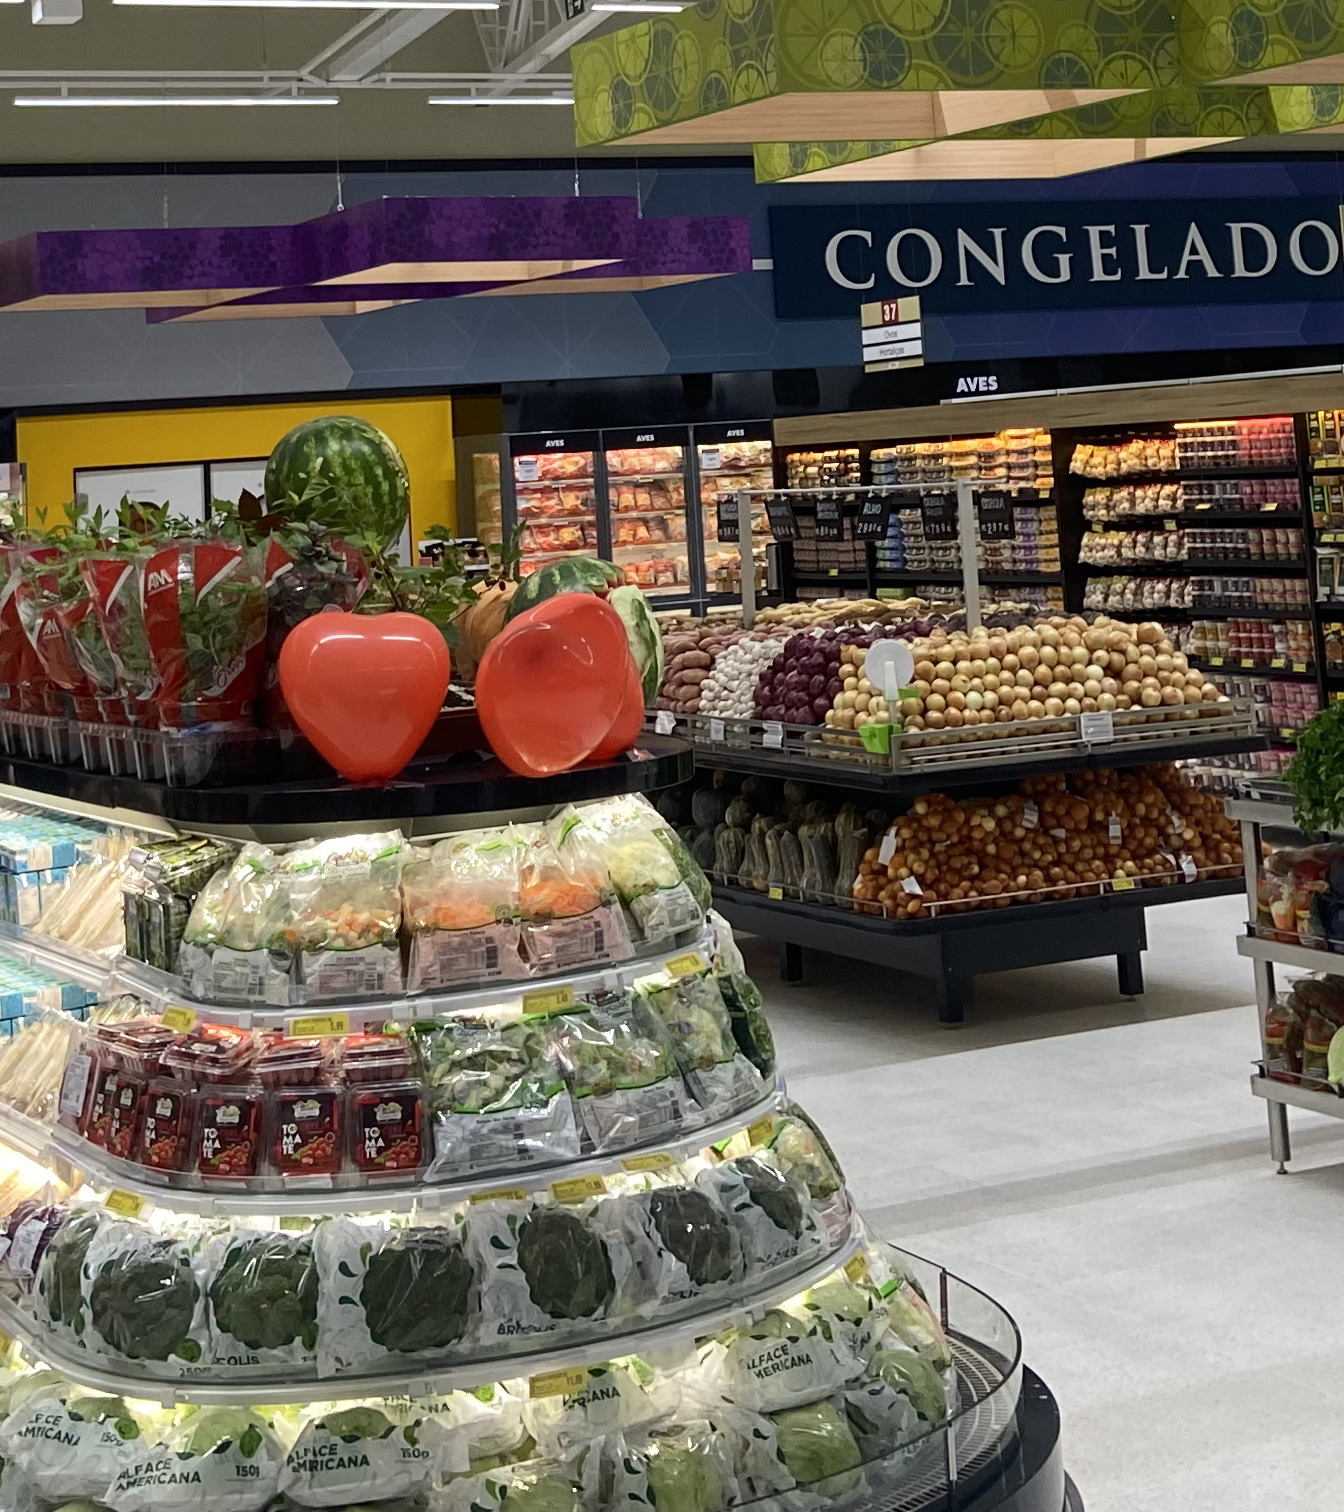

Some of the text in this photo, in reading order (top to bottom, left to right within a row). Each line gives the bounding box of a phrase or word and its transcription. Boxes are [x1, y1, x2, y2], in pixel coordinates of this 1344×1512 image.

[883, 303, 897, 321] 37
[956, 375, 998, 393] AVES
[635, 434, 654, 442] AVES
[727, 429, 745, 437] AVES
[545, 439, 565, 448] AVES
[117, 1457, 173, 1481] ALFACE
[114, 1471, 202, 1492] AMERICANA
